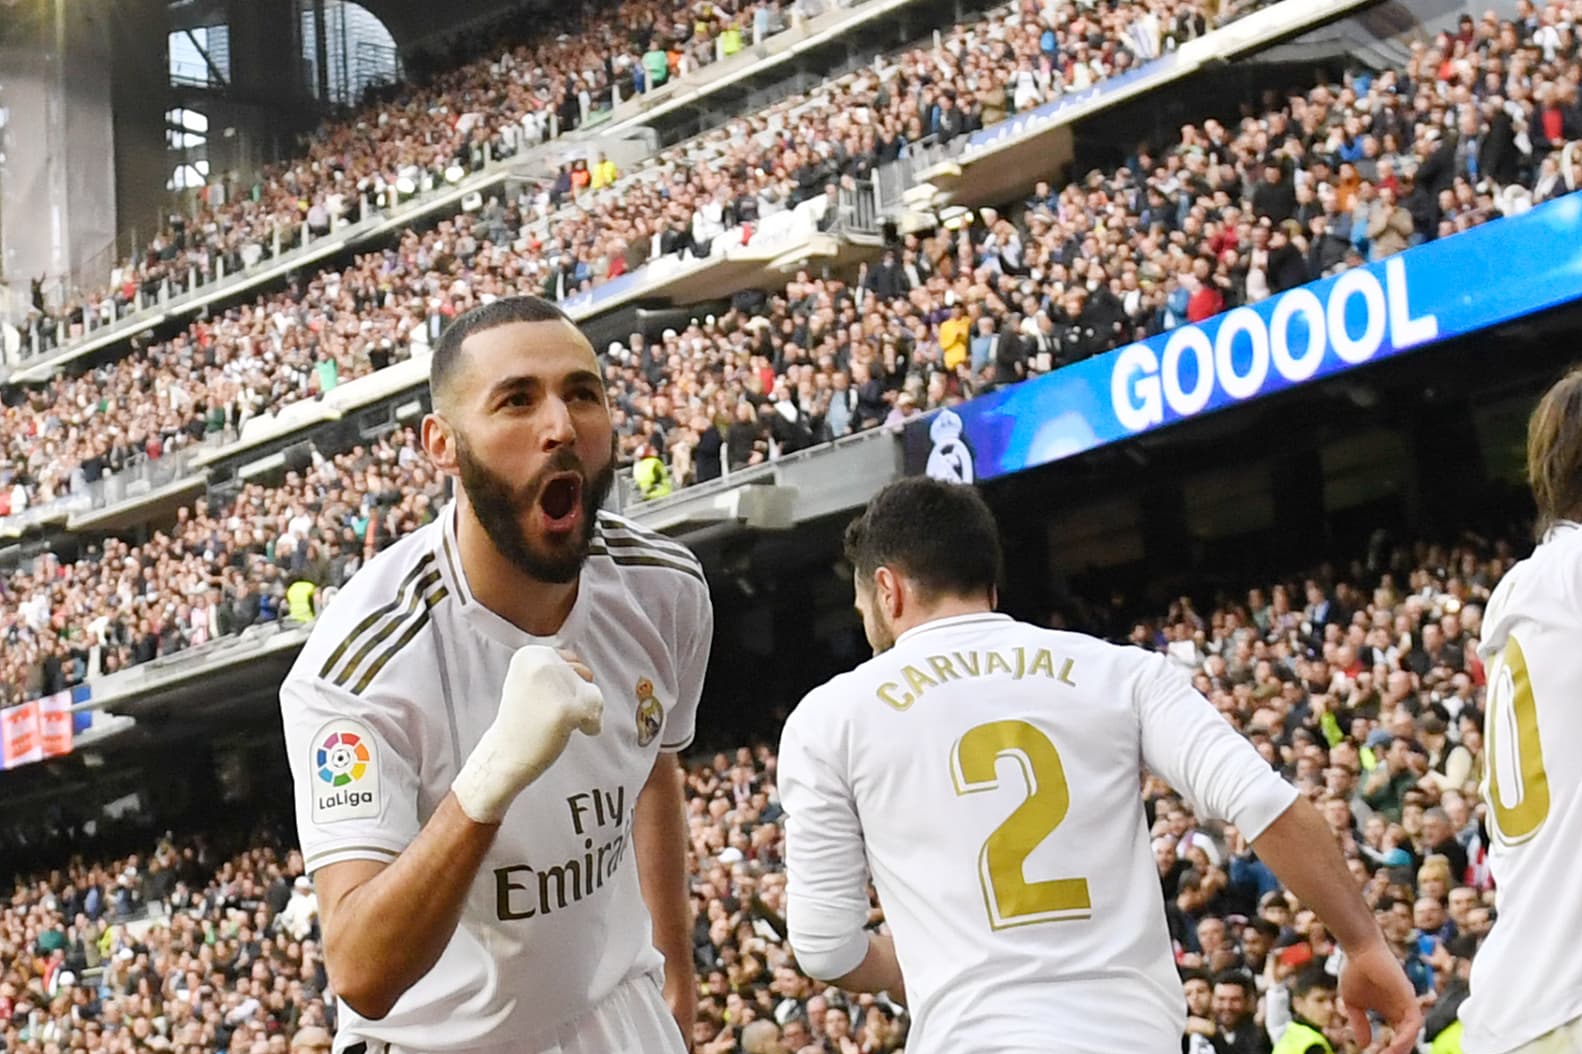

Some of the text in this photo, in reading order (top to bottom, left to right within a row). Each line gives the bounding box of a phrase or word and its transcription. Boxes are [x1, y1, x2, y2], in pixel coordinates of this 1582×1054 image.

[1110, 256, 1439, 432] GOOOOL
[875, 647, 1077, 712] CARVAJAL
[566, 786, 625, 836] Fly
[949, 719, 1092, 932] 2
